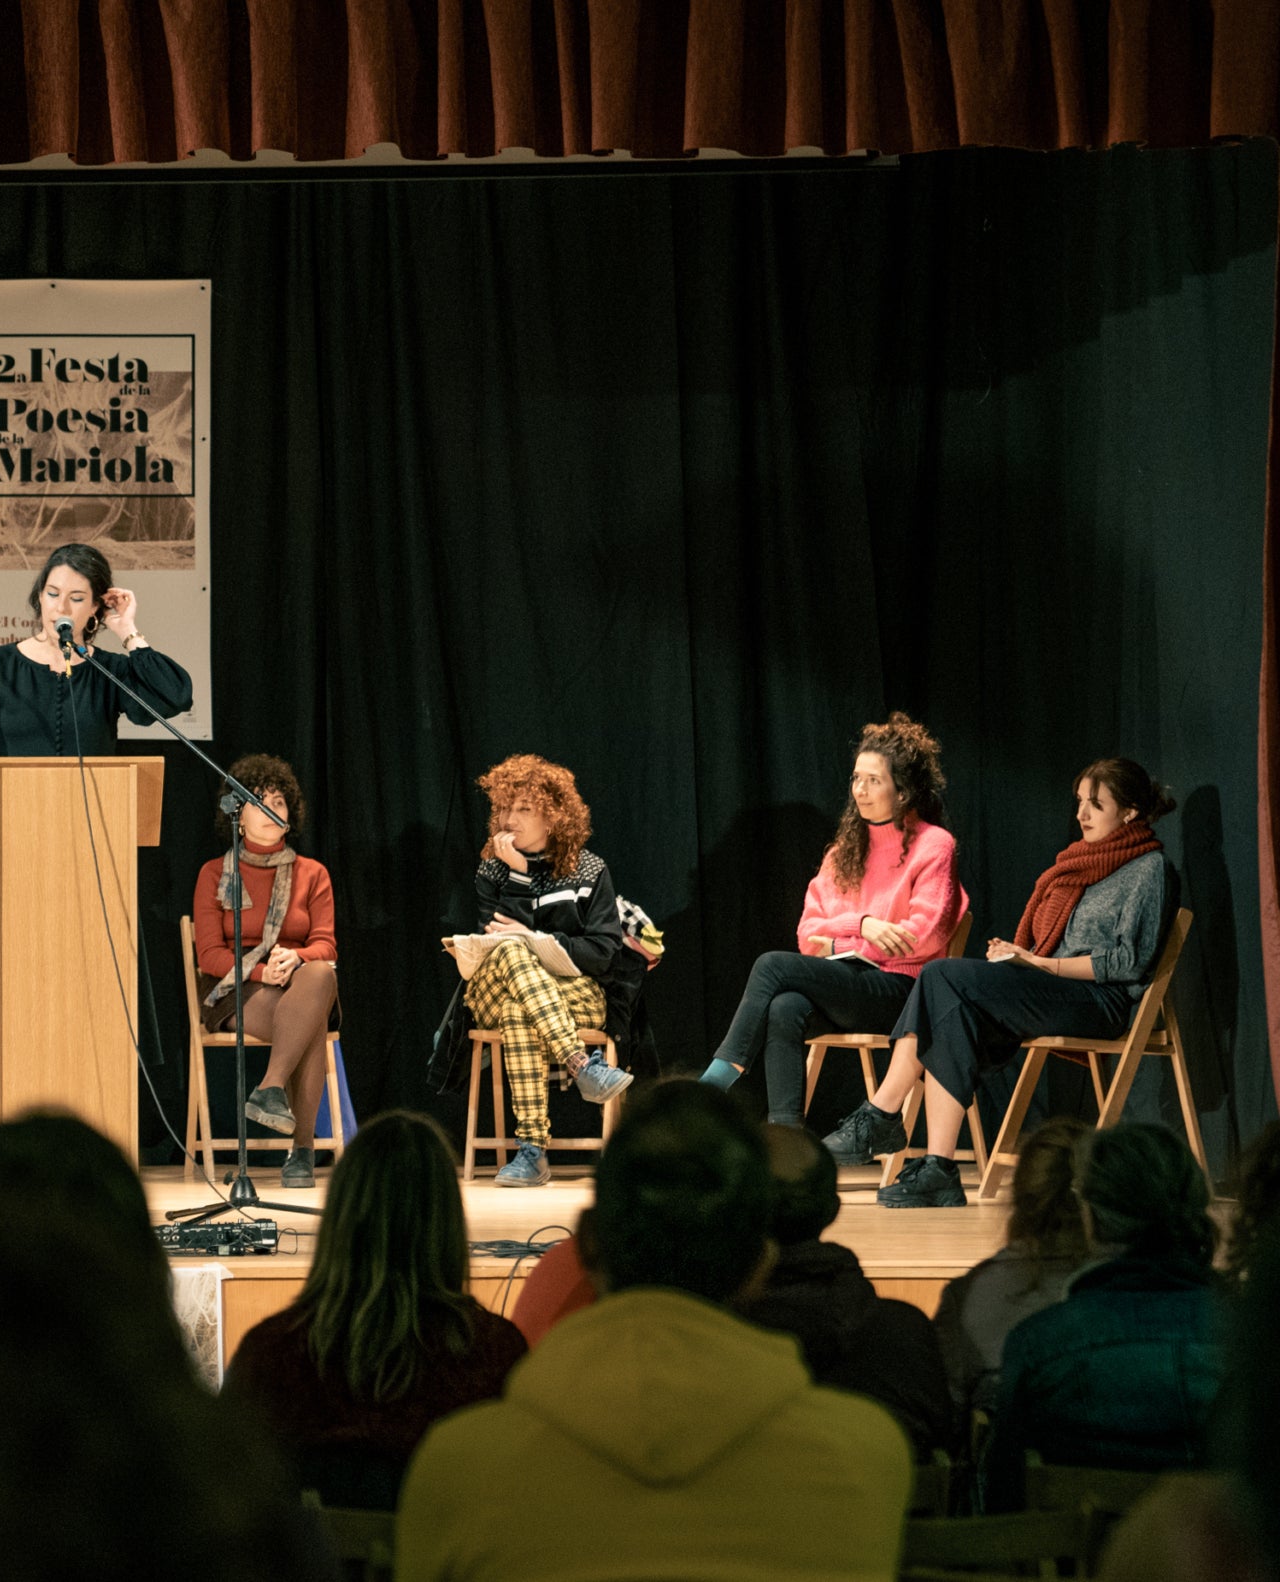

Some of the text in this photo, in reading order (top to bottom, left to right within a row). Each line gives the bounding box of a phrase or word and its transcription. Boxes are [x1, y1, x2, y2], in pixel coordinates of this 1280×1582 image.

[28, 348, 150, 383] Festa
[120, 384, 151, 396] de la
[12, 433, 24, 444] la
